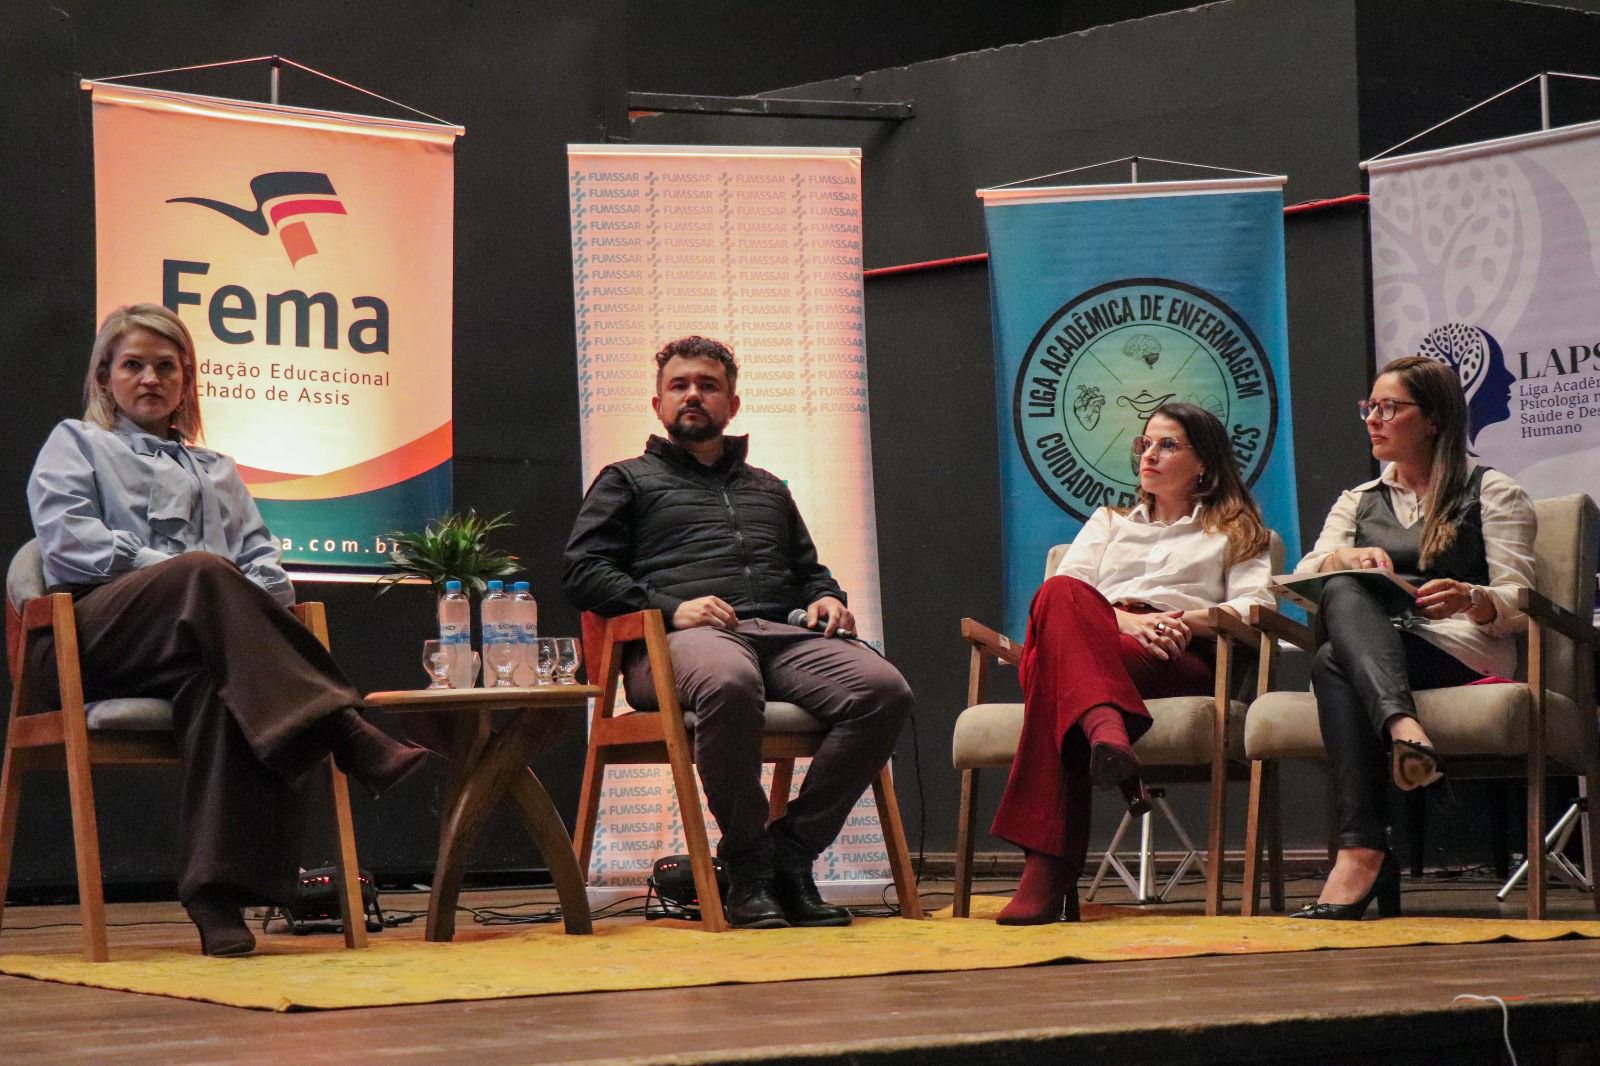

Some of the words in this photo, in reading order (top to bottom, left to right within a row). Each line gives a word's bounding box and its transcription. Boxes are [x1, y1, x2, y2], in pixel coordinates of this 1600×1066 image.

[589, 173, 639, 181] FUMSSAR
[662, 174, 712, 182] FUMSSAR
[736, 174, 785, 183] FUMSSAR
[809, 176, 856, 185] FUMSSAR
[590, 189, 640, 198] FUMSSAR
[663, 190, 712, 199] FUMSSAR
[737, 191, 786, 200] FUMSSAR
[810, 192, 858, 201] FUMSSAR
[590, 205, 640, 214] FUMSSAR
[664, 206, 713, 215] FUMSSAR
[737, 207, 786, 216] FUMSSAR
[810, 208, 858, 217] FUMSSAR
[591, 222, 640, 230] FUMSSAR
[664, 222, 714, 231] FUMSSAR
[738, 223, 787, 232] FUMSSAR
[811, 224, 859, 233] FUMSSAR
[591, 238, 641, 246] FUMSSAR
[665, 239, 714, 248] FUMSSAR
[739, 240, 788, 248] FUMSSAR
[812, 240, 860, 249] FUMSSAR
[592, 255, 642, 263] FUMSSAR
[666, 255, 715, 264] FUMSSAR
[740, 256, 789, 265] FUMSSAR
[813, 256, 860, 266] FUMSSAR
[592, 271, 642, 279] FUMSSAR
[666, 271, 716, 280] FUMSSAR
[740, 272, 789, 280] FUMSSAR
[814, 272, 861, 281] FUMSSAR
[593, 287, 643, 296] FUMSSAR
[667, 288, 717, 297] FUMSSAR
[741, 288, 790, 297] FUMSSAR
[815, 288, 862, 298] FUMSSAR
[162, 259, 390, 355] Fema
[594, 304, 644, 312] FUMSSAR
[668, 304, 717, 313] FUMSSAR
[742, 305, 791, 314] FUMSSAR
[816, 305, 863, 314] FUMSSAR
[1140, 294, 1164, 321] DE
[594, 321, 645, 330] FUMSSAR
[668, 321, 718, 330] FUMSSAR
[742, 322, 792, 330] FUMSSAR
[816, 322, 863, 331] FUMSSAR
[1040, 296, 1136, 376] ACADÊMICA
[595, 337, 645, 346] FUMSSAR
[743, 338, 792, 346] FUMSSAR
[816, 338, 864, 347] FUMSSAR
[1167, 297, 1264, 400] ENFERMAGEM
[596, 354, 646, 363] FUMSSAR
[744, 355, 794, 363] FUMSSAR
[818, 354, 865, 363] FUMSSAR
[200, 358, 260, 380] dação
[271, 363, 390, 387] Educacional
[596, 371, 646, 379] FUMSSAR
[744, 371, 794, 380] FUMSSAR
[818, 371, 865, 380] FUMSSAR
[197, 381, 255, 400] chado
[265, 385, 288, 402] de
[298, 386, 350, 406] Assis
[597, 388, 646, 396] FUMSSAR
[745, 388, 795, 397] FUMSSAR
[820, 387, 866, 396] FUMSSAR
[1028, 376, 1059, 418] LIGA
[1520, 384, 1548, 399] Liga
[1520, 393, 1589, 410] Psicologia
[597, 404, 647, 413] FUMSSAR
[746, 404, 796, 413] FUMSSAR
[820, 403, 868, 413] FUMSSAR
[1520, 410, 1562, 424] Saúde
[1567, 410, 1574, 420] e
[1521, 423, 1582, 438] Humano
[1036, 432, 1115, 508] CUIDADOS
[282, 537, 400, 554] a.com.br
[608, 768, 660, 779] FUMSSAR
[609, 786, 661, 797] FUMSSAR
[610, 804, 662, 815] FUMSSAR
[610, 822, 662, 833] FUMSSAR
[611, 841, 663, 851] FUMSSAR
[611, 860, 655, 870] FUMSSA
[842, 852, 888, 863] FUMSSA
